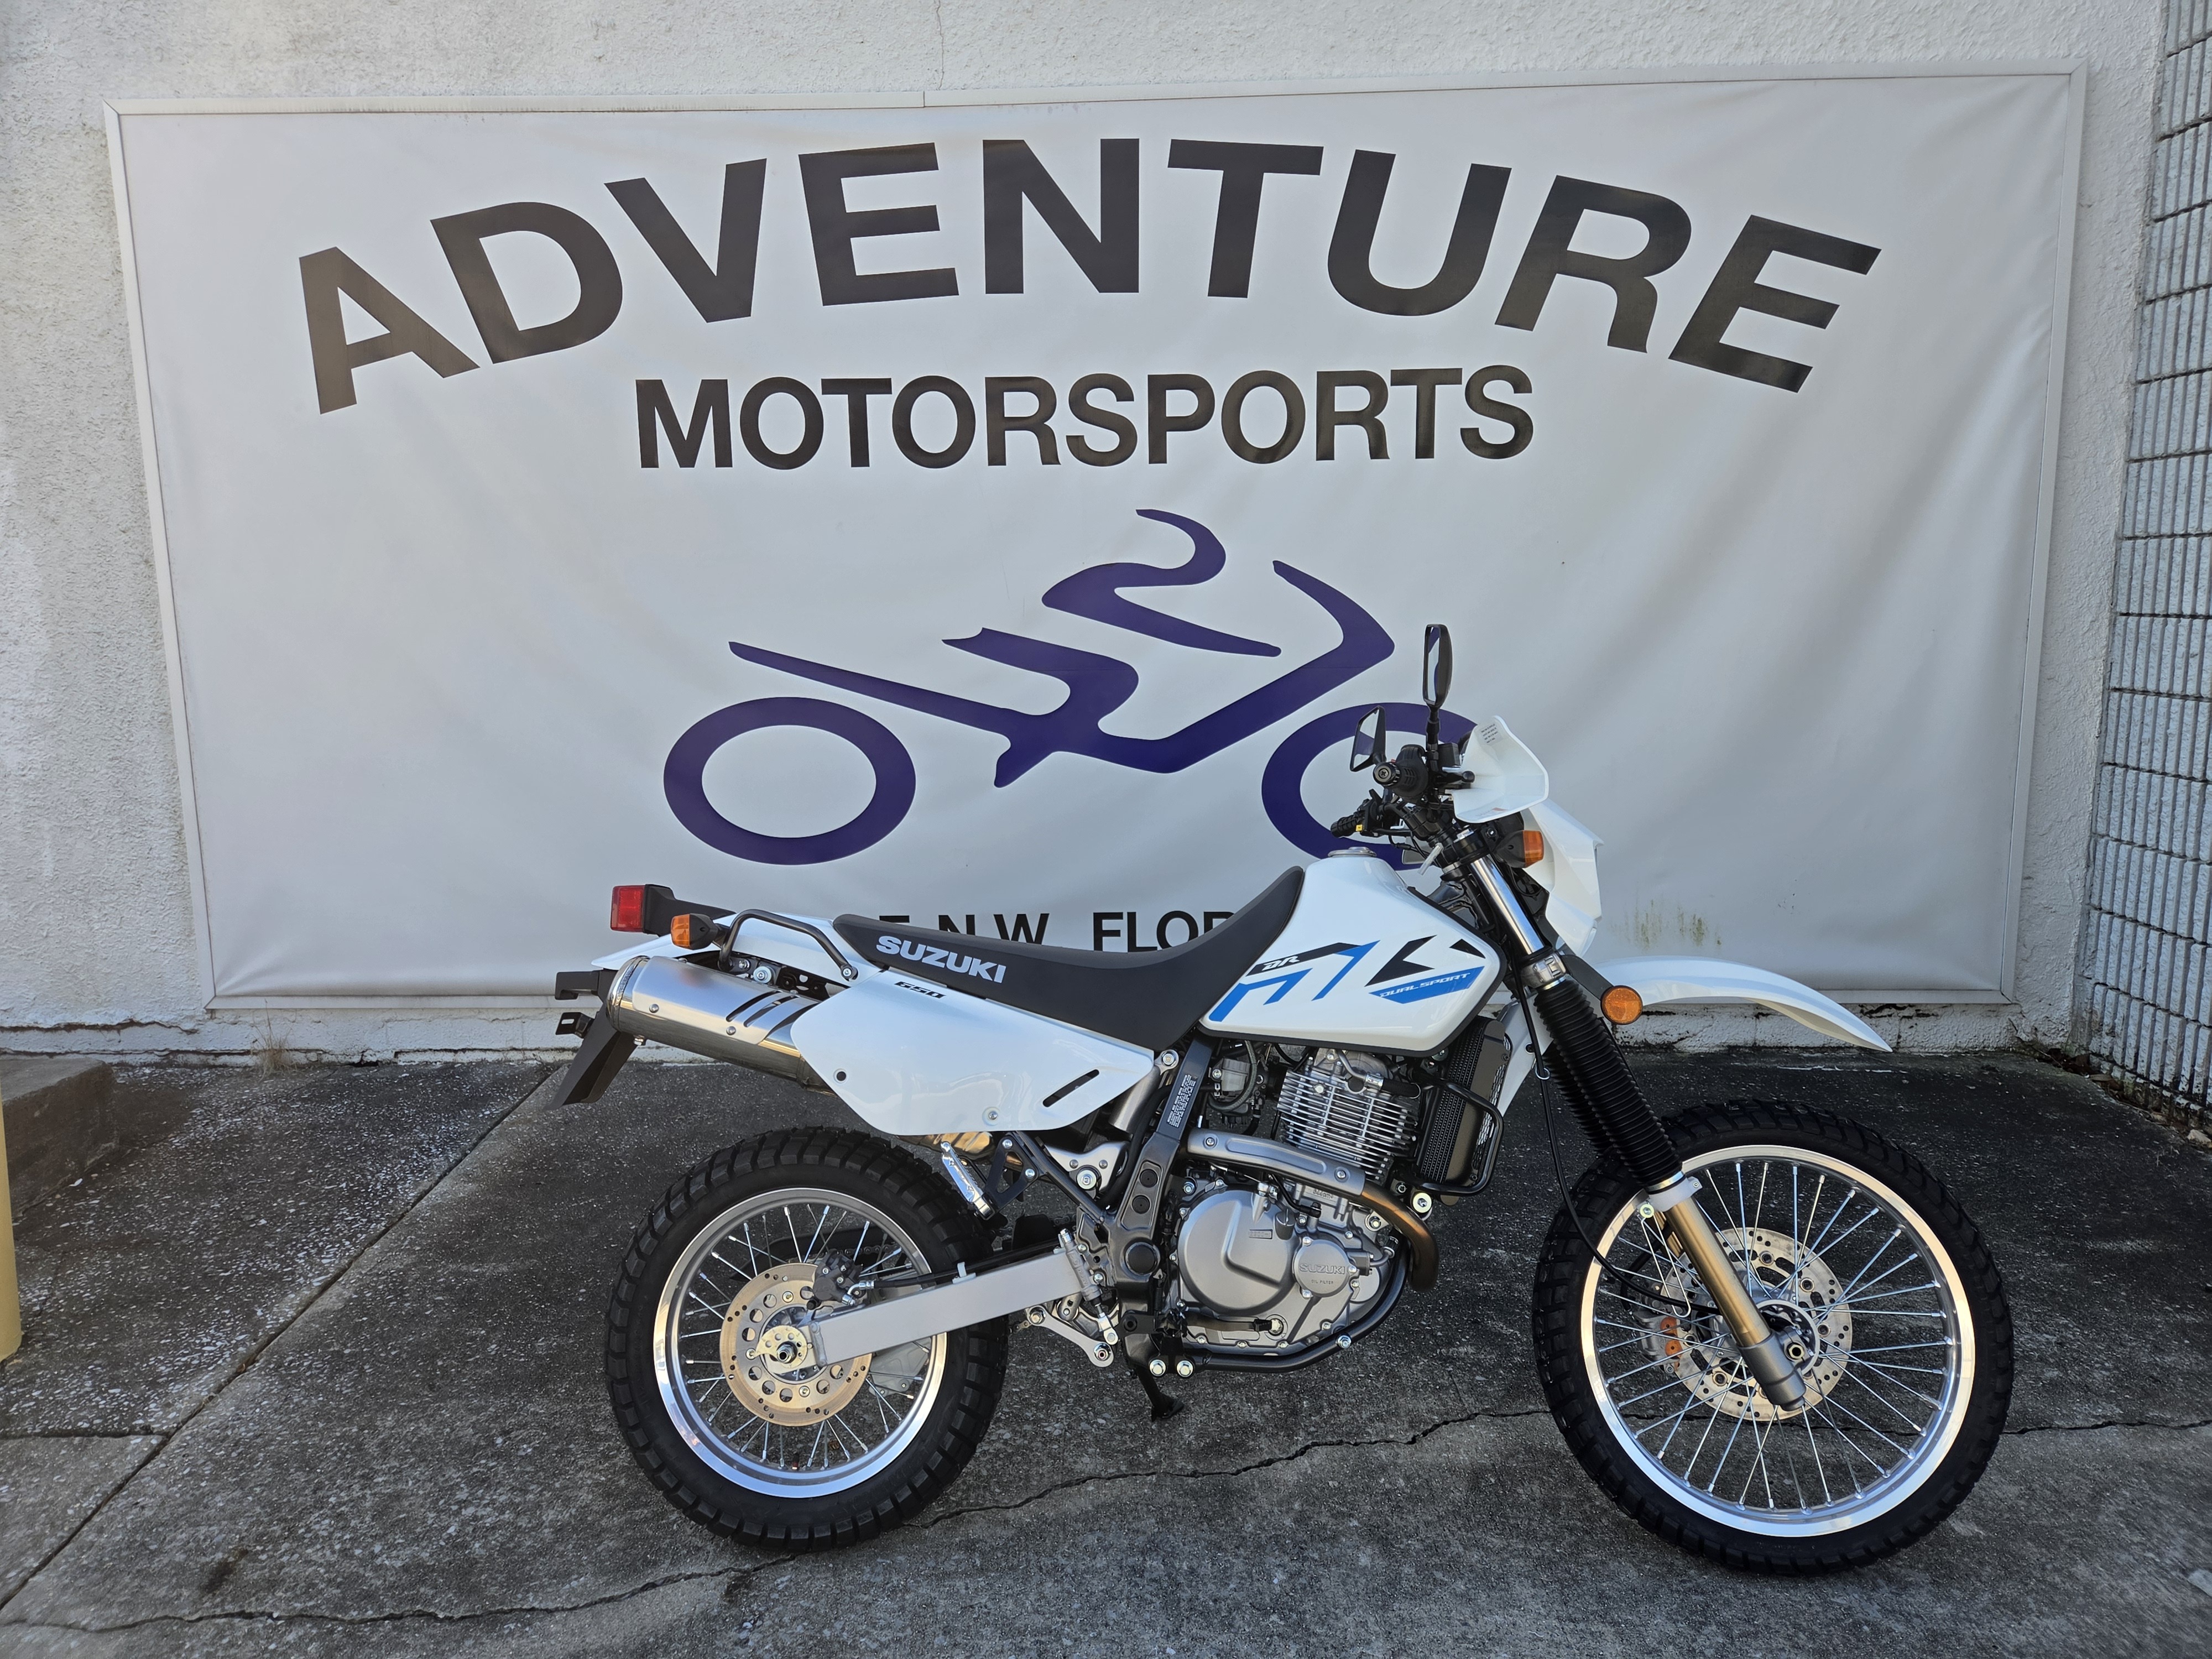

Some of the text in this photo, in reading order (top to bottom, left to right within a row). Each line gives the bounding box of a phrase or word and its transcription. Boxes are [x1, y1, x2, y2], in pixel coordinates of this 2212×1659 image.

[299, 139, 1881, 414] ADVENTURE
[636, 365, 1533, 469] MOTORSPORTS
[876, 936, 1007, 983] SUZUKI
[1261, 956, 1300, 972] DR
[894, 980, 947, 999] 650
[1300, 1263, 1345, 1274] SUZUKI
